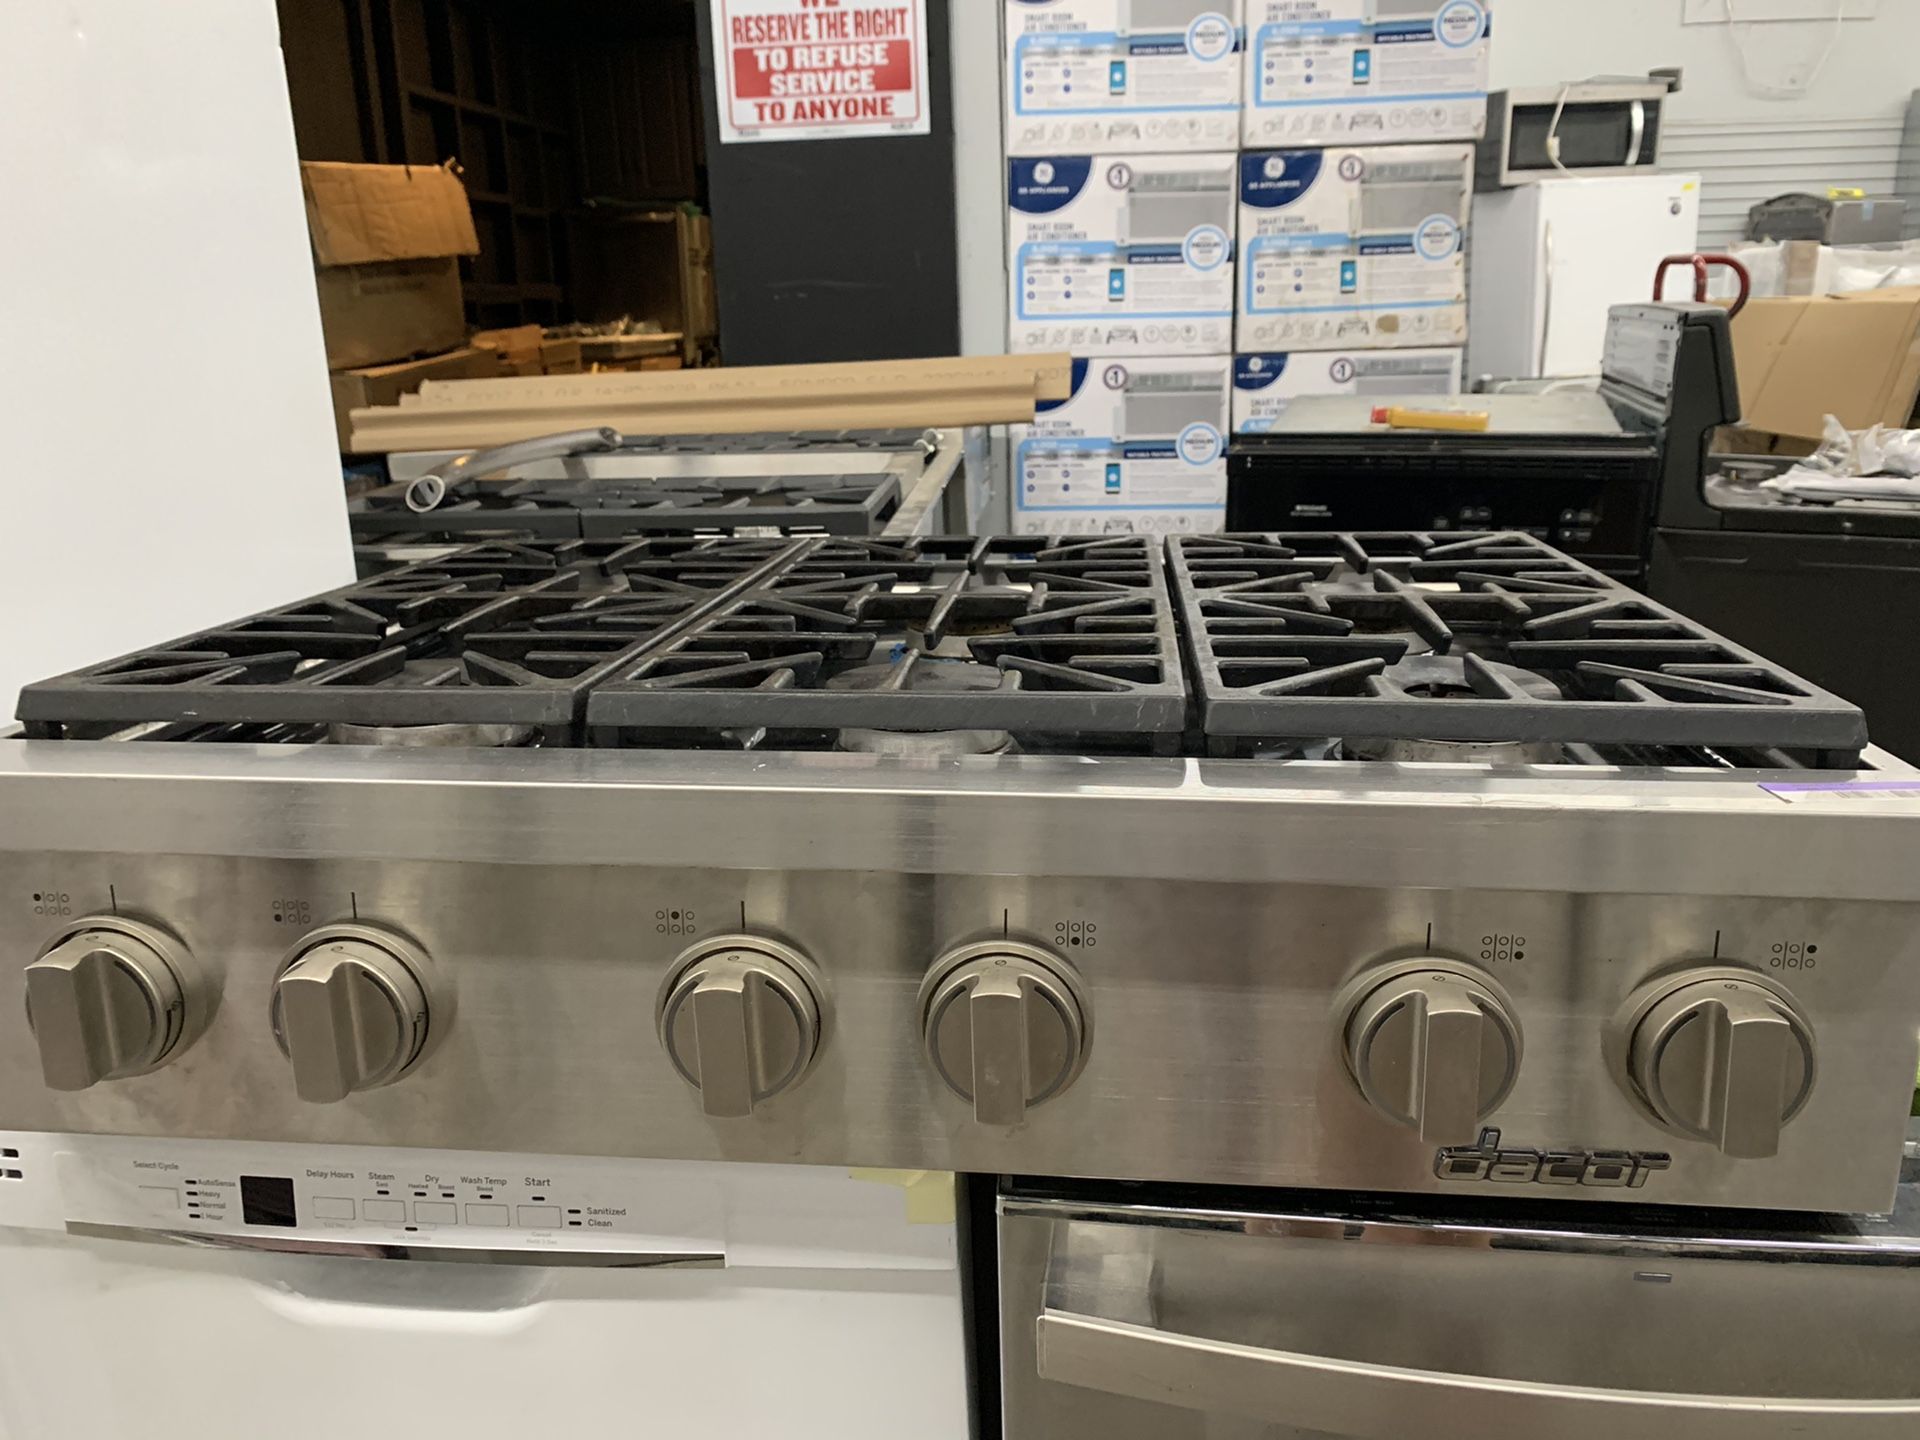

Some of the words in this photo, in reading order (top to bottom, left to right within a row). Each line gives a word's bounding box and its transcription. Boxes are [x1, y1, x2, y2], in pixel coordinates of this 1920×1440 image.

[732, 13, 811, 43] RESERVE
[815, 11, 849, 39] THE
[855, 8, 908, 37] RIGHT
[753, 48, 788, 72] TO
[794, 43, 889, 69] REFUSE
[769, 68, 876, 96] SERVICE
[755, 102, 785, 122] TO
[793, 96, 895, 120] ANYONE
[1433, 1126, 1672, 1188] dacor
[133, 1160, 156, 1169] Select
[158, 1162, 179, 1171] Cycle
[306, 1169, 328, 1179] Delay
[330, 1170, 354, 1179] Hours
[368, 1172, 395, 1180] Steam
[425, 1174, 439, 1184] Dry
[460, 1176, 483, 1184] Wash
[485, 1177, 508, 1187] Temp
[524, 1176, 551, 1187] Start
[586, 1206, 627, 1216] Sanitized
[587, 1218, 613, 1227] Clean
